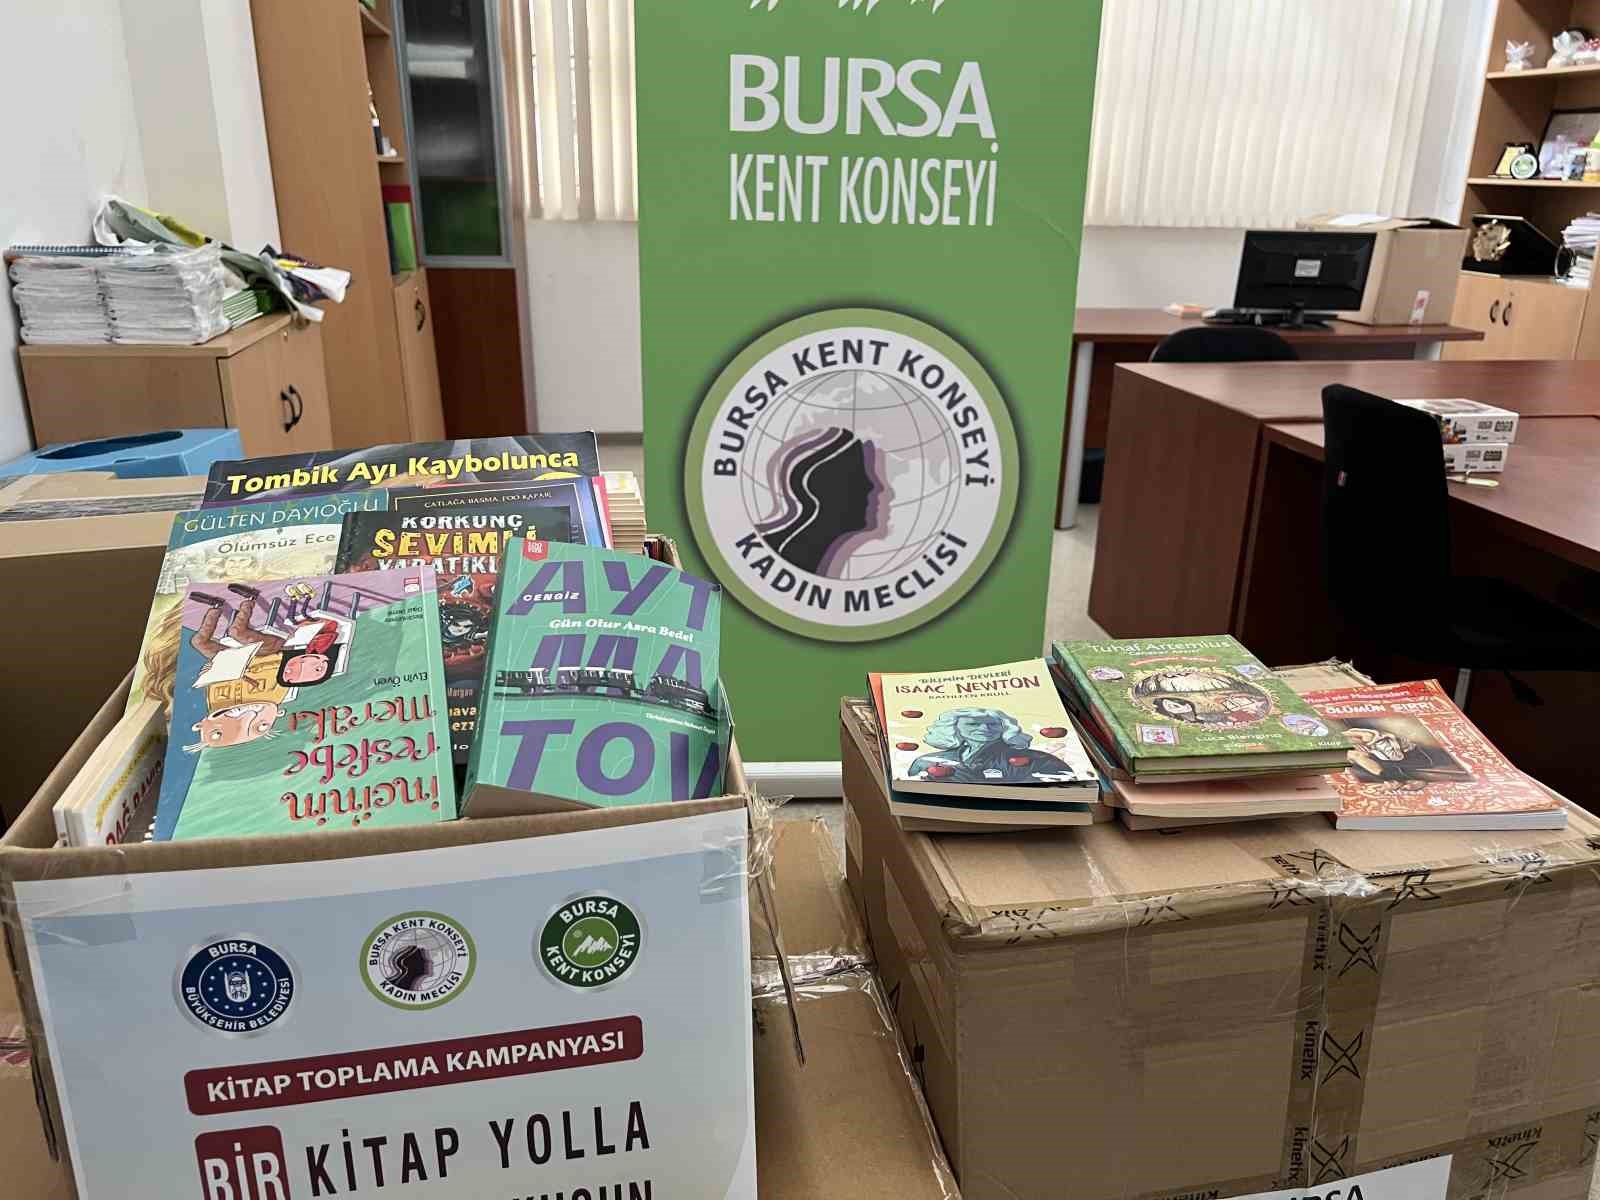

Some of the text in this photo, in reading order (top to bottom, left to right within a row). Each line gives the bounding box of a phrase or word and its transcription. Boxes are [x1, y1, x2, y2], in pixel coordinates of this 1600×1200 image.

[729, 54, 997, 139] BURSA
[729, 142, 999, 226] KENT KONSEYİ
[713, 339, 995, 487] BURSA KENT KONSEYİ
[226, 450, 579, 495] Tombik Ayı Kaybolunca
[183, 496, 379, 534] GÜLTEN DAYIOĞLU
[401, 514, 523, 531] KORKUNÇ
[217, 532, 336, 555] Ölümsüz Ece
[735, 530, 968, 613] KADIN MECLİSİ
[549, 619, 582, 629] Gün
[585, 618, 619, 630] Olur
[658, 624, 694, 642] Bedel
[403, 672, 428, 683] Elvin
[895, 675, 1041, 695] ISAAC NEWTON
[287, 693, 434, 745] merakı
[284, 731, 440, 786] resfebe
[560, 900, 618, 923] BURSA
[208, 942, 257, 958] BURSA
[369, 919, 468, 966] BURSA KENT KONSEYİ
[546, 933, 636, 983] KENT KONSEYİ
[248, 977, 291, 1029] BELEDİYESİ
[379, 970, 463, 1002] KADIN MECLİSİ
[207, 1030, 624, 1103] KİTAP TOPLAMA KAMPANYASI
[203, 1100, 651, 1200] BİR KİTAP YOLLA
